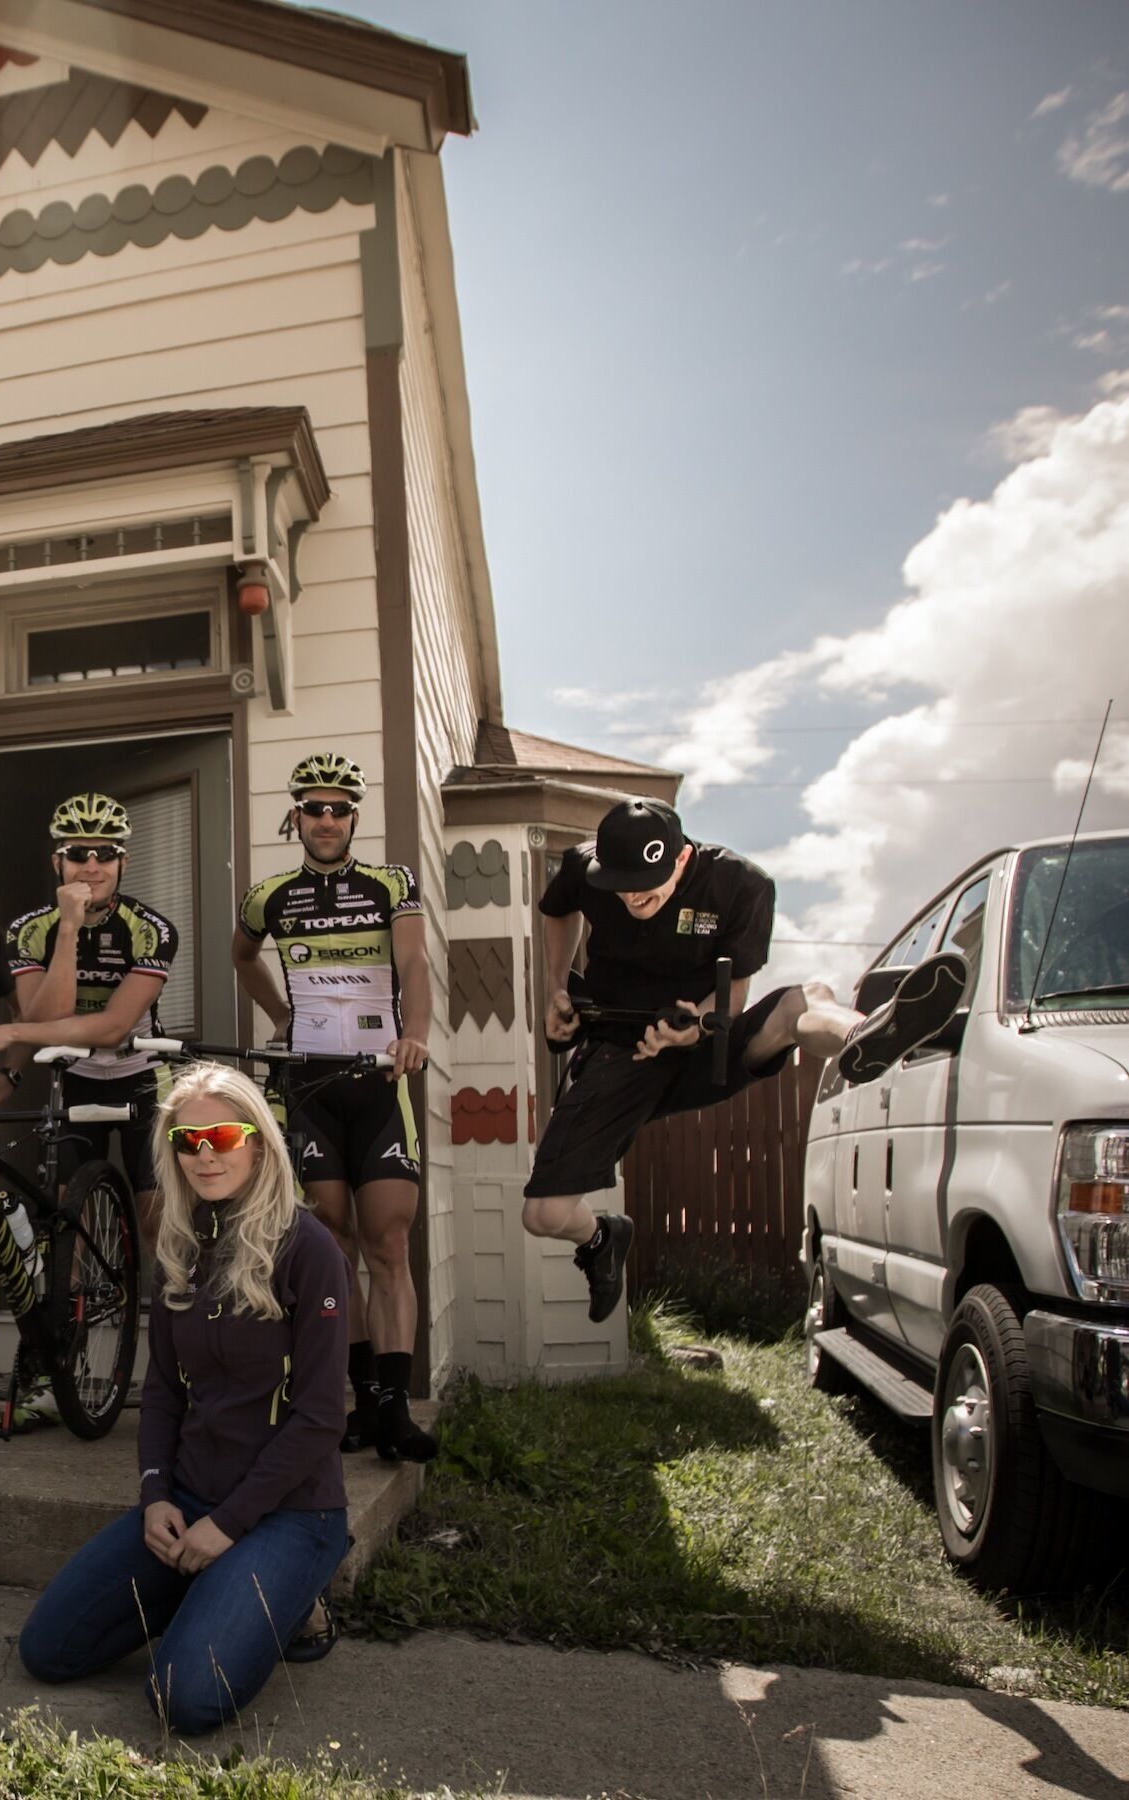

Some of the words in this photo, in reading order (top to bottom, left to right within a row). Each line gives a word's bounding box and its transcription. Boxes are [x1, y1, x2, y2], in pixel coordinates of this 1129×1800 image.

[10, 904, 54, 929] TOPEAK
[299, 911, 385, 931] TOPEAK
[143, 910, 170, 944] TOPEAK
[318, 945, 382, 958] ERGON
[77, 970, 126, 982] OPEA
[308, 974, 372, 985] CANYON
